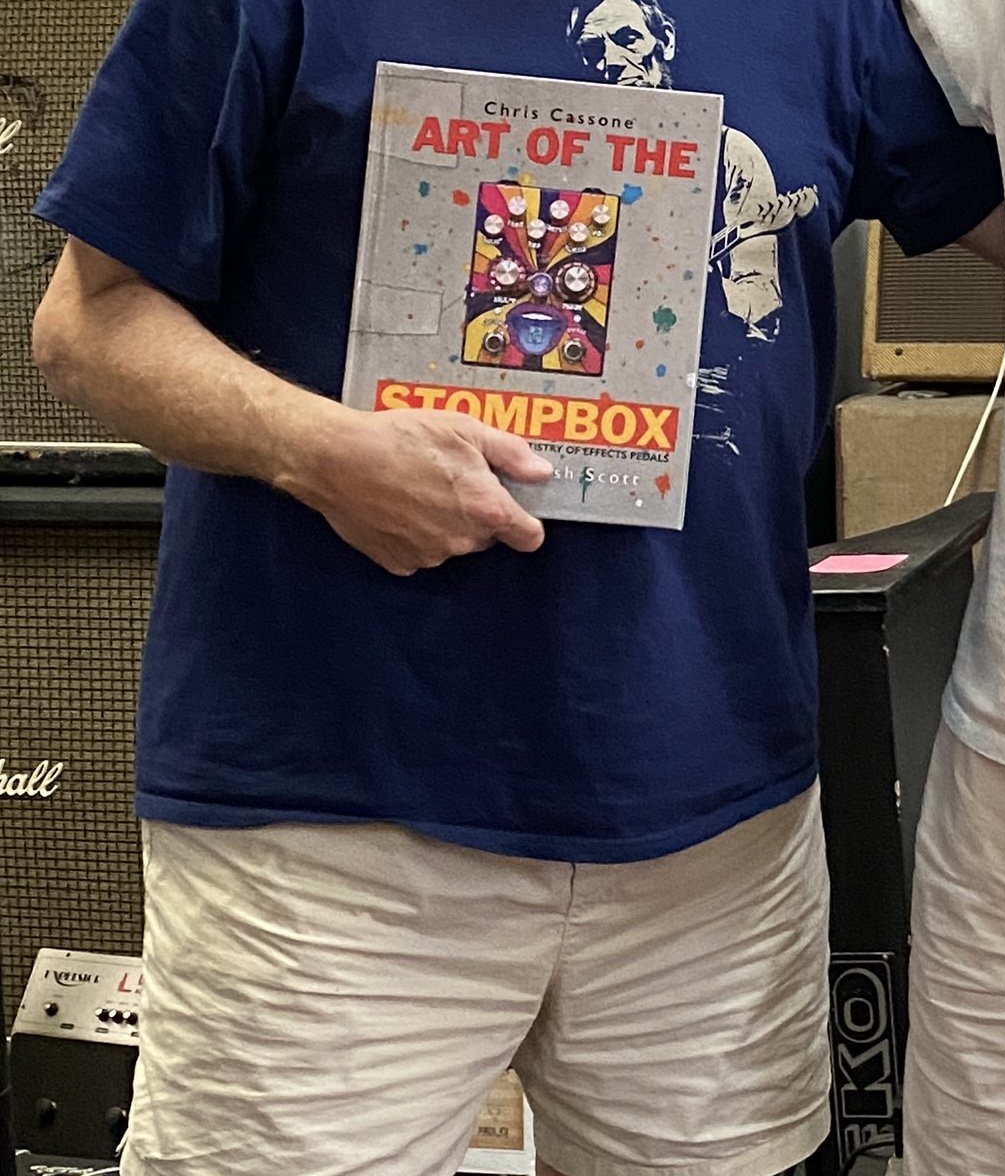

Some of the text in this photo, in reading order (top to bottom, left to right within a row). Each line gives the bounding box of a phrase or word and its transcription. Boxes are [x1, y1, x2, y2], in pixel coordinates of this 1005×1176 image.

[484, 101, 634, 129] Chris Cassone
[412, 117, 698, 179] ART OF THE
[380, 384, 673, 449] STOMPBOX
[529, 442, 670, 463] TISTRY OF EFFECTS PEDALS
[554, 466, 639, 486] sh Scott
